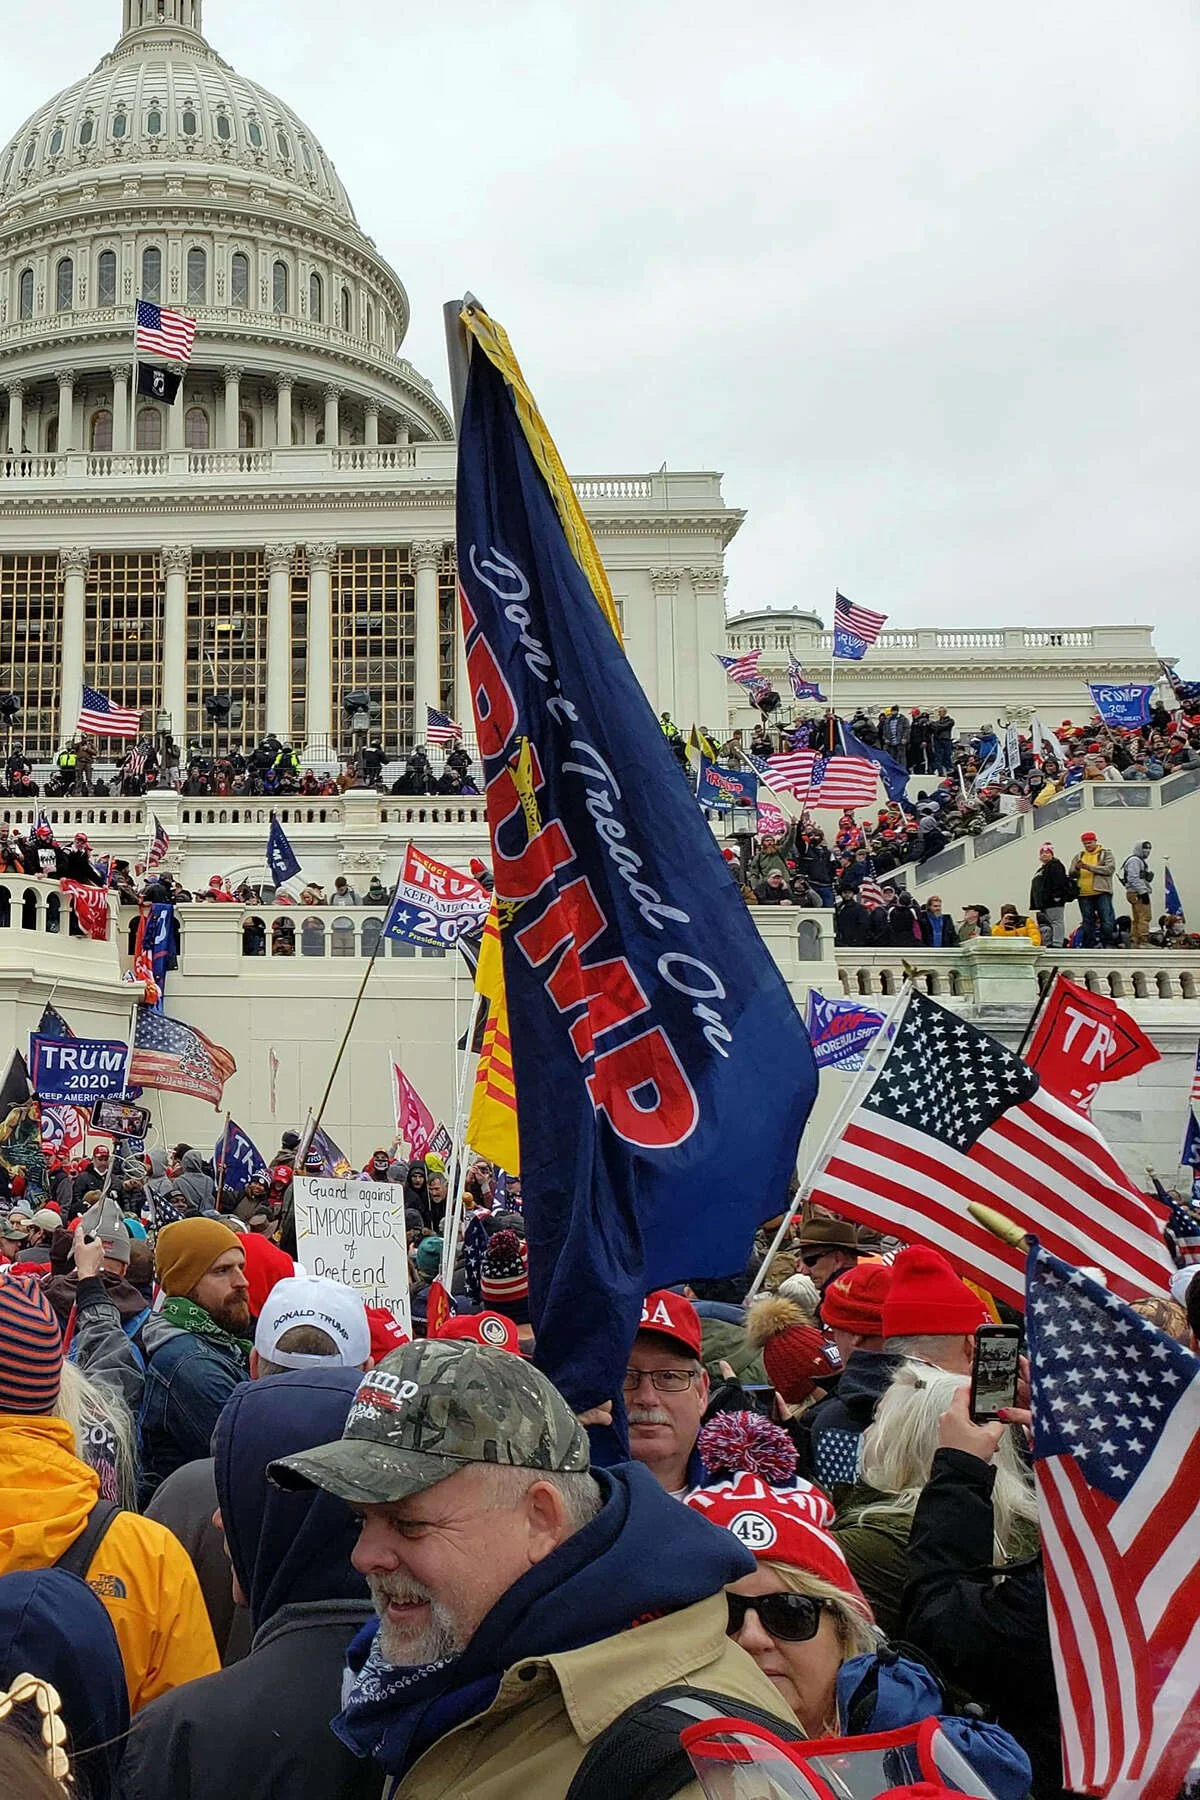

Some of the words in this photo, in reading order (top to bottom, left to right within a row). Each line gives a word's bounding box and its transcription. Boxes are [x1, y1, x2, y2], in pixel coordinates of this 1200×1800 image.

[469, 544, 579, 726] Don't
[562, 740, 690, 929] Tread
[657, 952, 733, 1058] On
[458, 580, 699, 1149] RUMP
[403, 887, 435, 905] KEEP
[392, 925, 406, 935] For
[408, 931, 447, 948] President
[41, 1045, 128, 1071] TRUM
[64, 1074, 116, 1089] -2020-
[38, 1092, 62, 1101] KEEP
[359, 1187, 397, 1209] against
[306, 1205, 392, 1239] IMPOSTURES
[344, 1240, 357, 1260] of
[639, 1297, 675, 1328] SA
[273, 1309, 316, 1331] DONALD
[318, 1312, 349, 1341] TRUMP
[737, 1521, 765, 1541] 45
